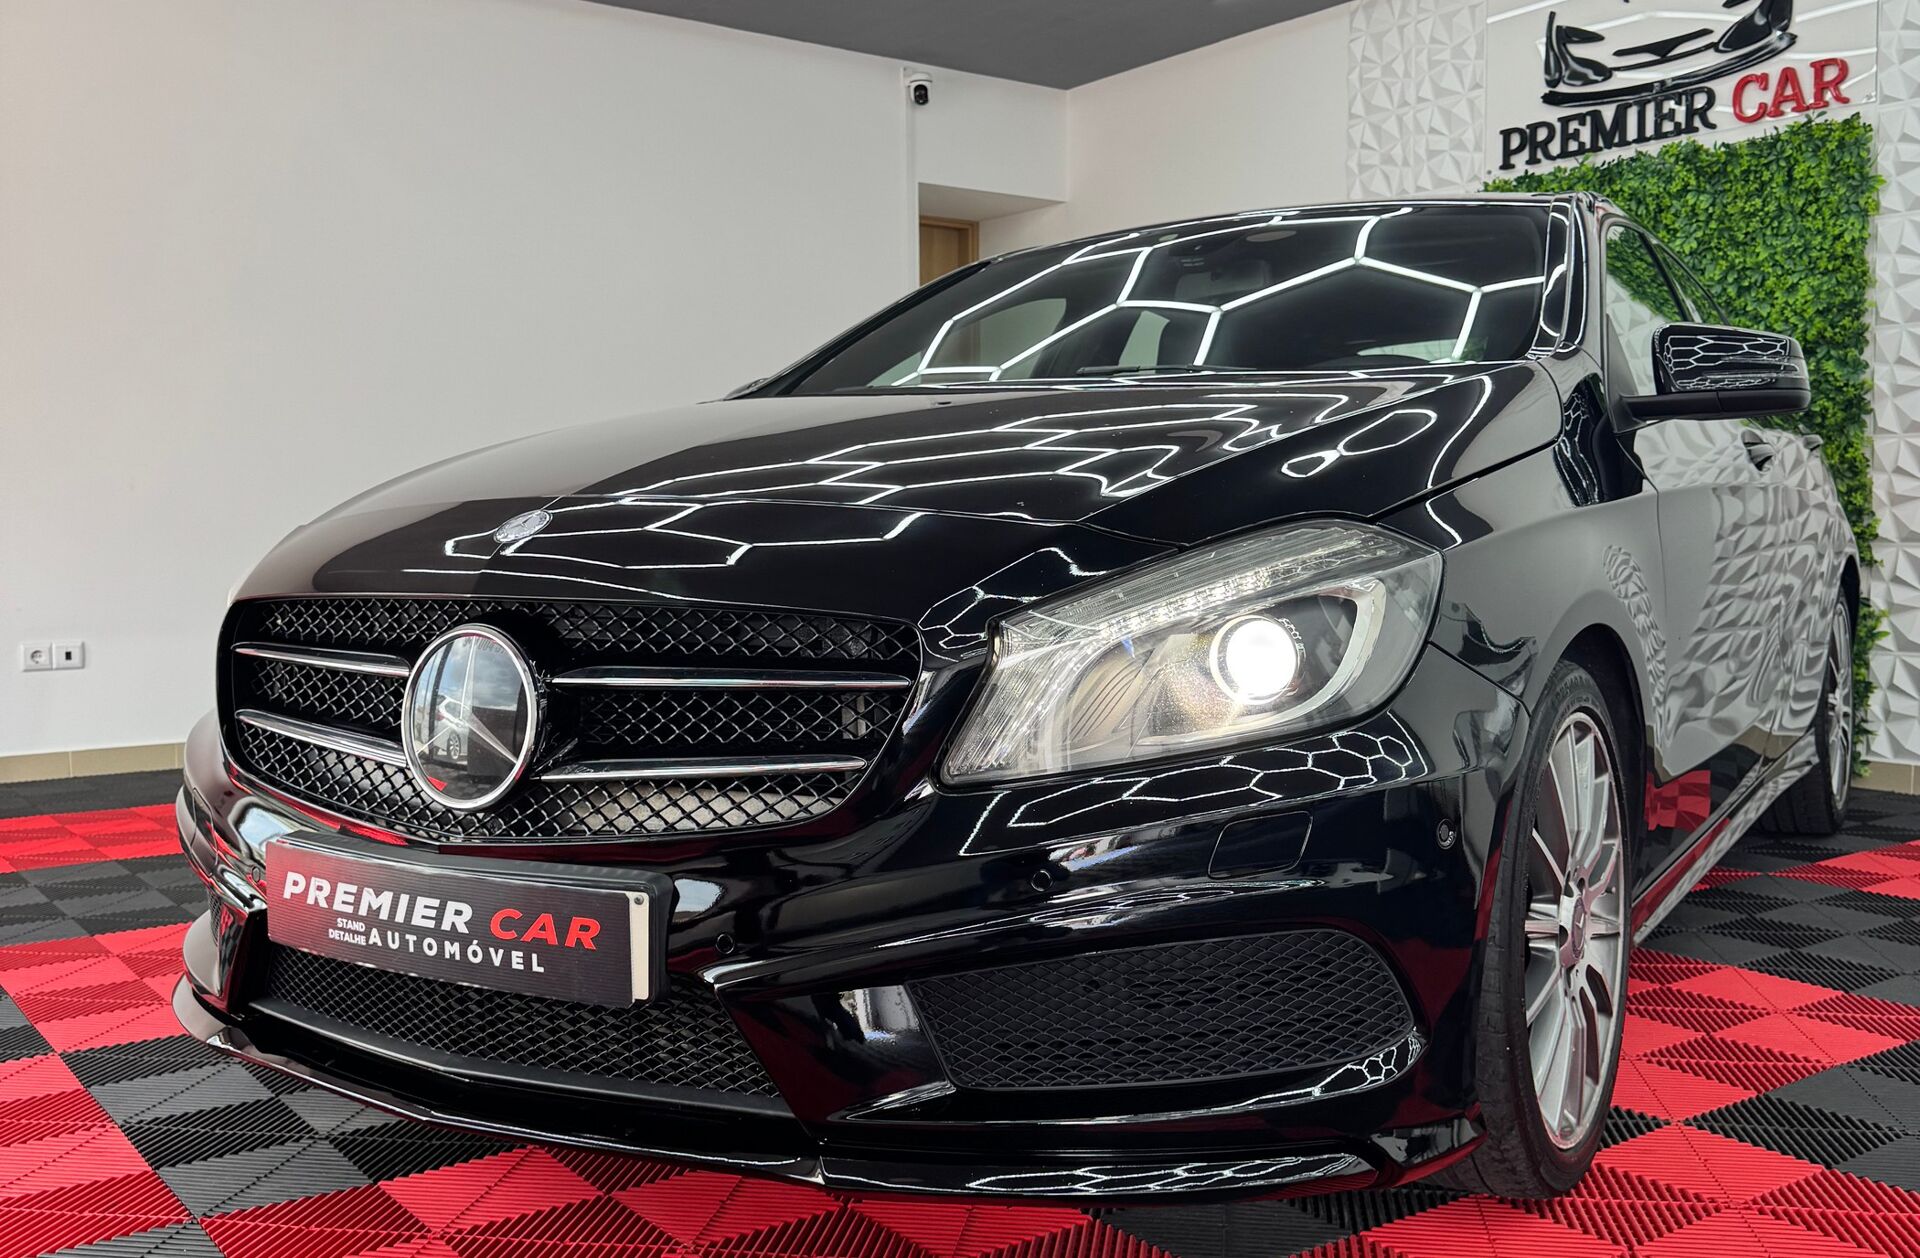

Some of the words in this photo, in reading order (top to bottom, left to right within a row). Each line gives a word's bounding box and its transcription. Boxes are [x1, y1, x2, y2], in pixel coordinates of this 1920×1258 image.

[1499, 87, 1717, 170] PREMIER
[1732, 57, 1850, 123] CAR
[283, 871, 473, 934] PREMIER
[489, 908, 601, 950] CAR
[336, 917, 366, 932] STAND
[328, 928, 367, 945] DETALHE
[368, 927, 545, 973] AUTOMÓVEL
